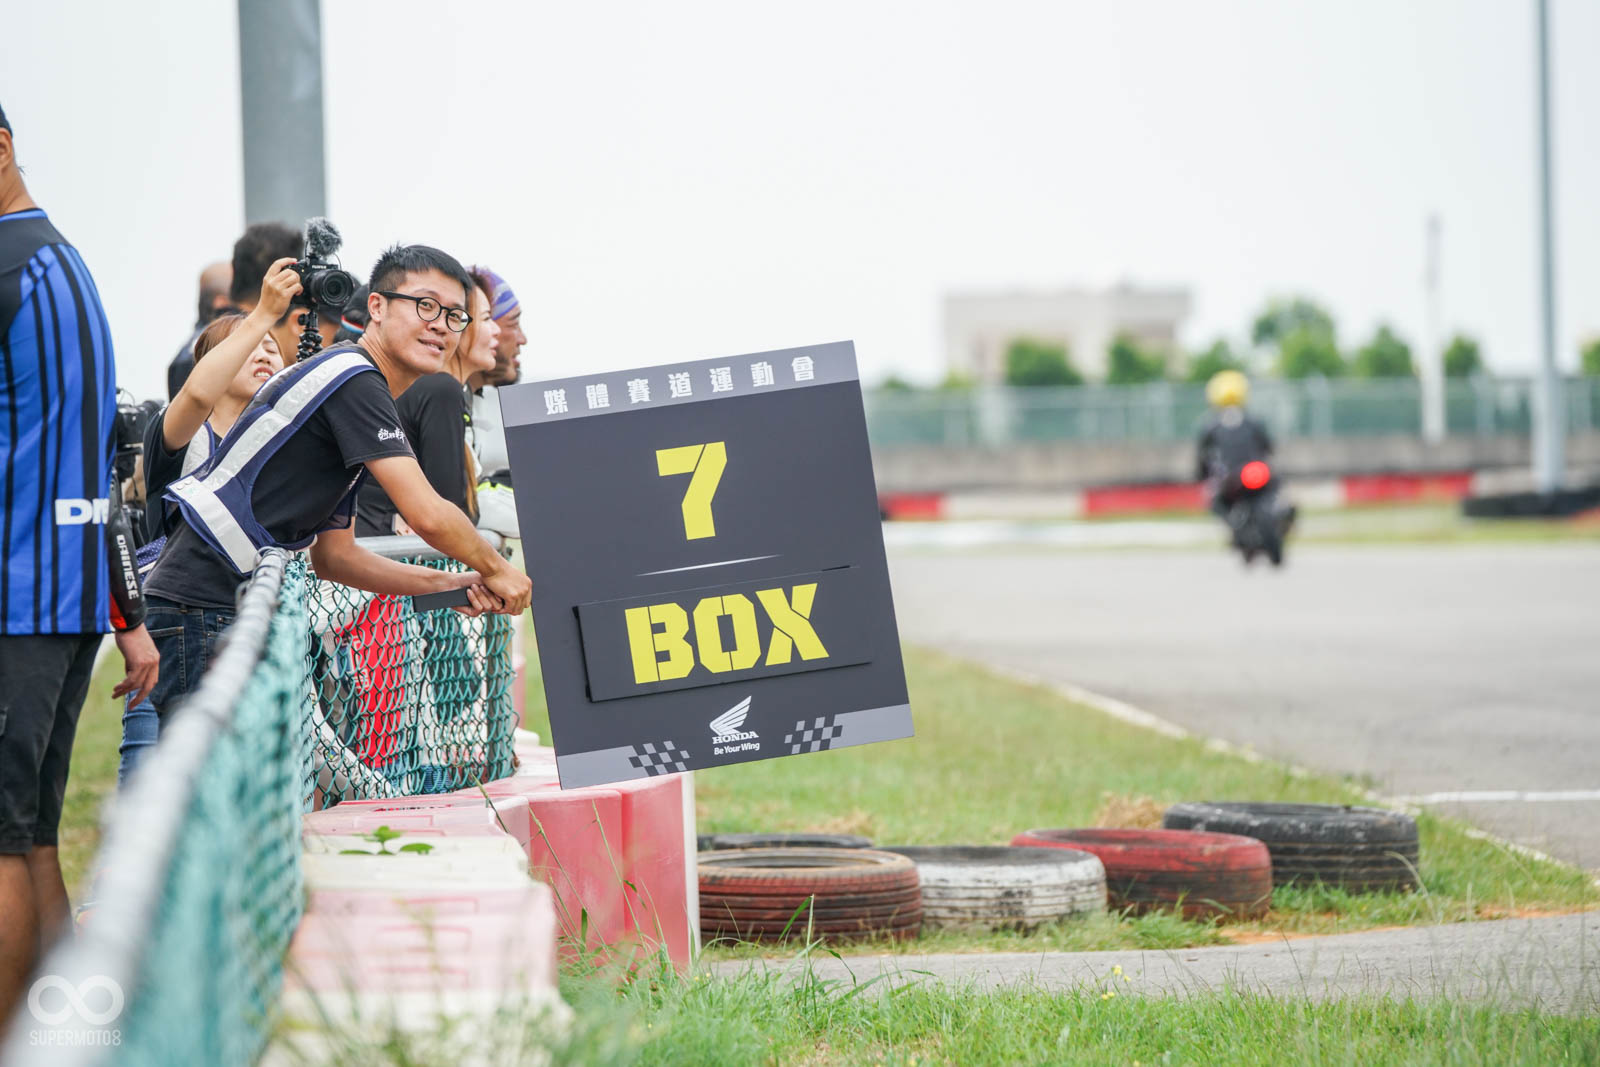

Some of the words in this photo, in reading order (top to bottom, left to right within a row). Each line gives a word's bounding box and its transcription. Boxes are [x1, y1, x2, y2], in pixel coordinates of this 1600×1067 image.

[543, 355, 815, 415] 媒體賽道運動會
[656, 441, 728, 541] 7
[116, 534, 140, 600] DAINESE
[624, 583, 829, 685] BOX
[712, 731, 759, 744] HONDA
[714, 747, 724, 755] Be
[724, 745, 741, 753] Your
[741, 743, 760, 751] Wing
